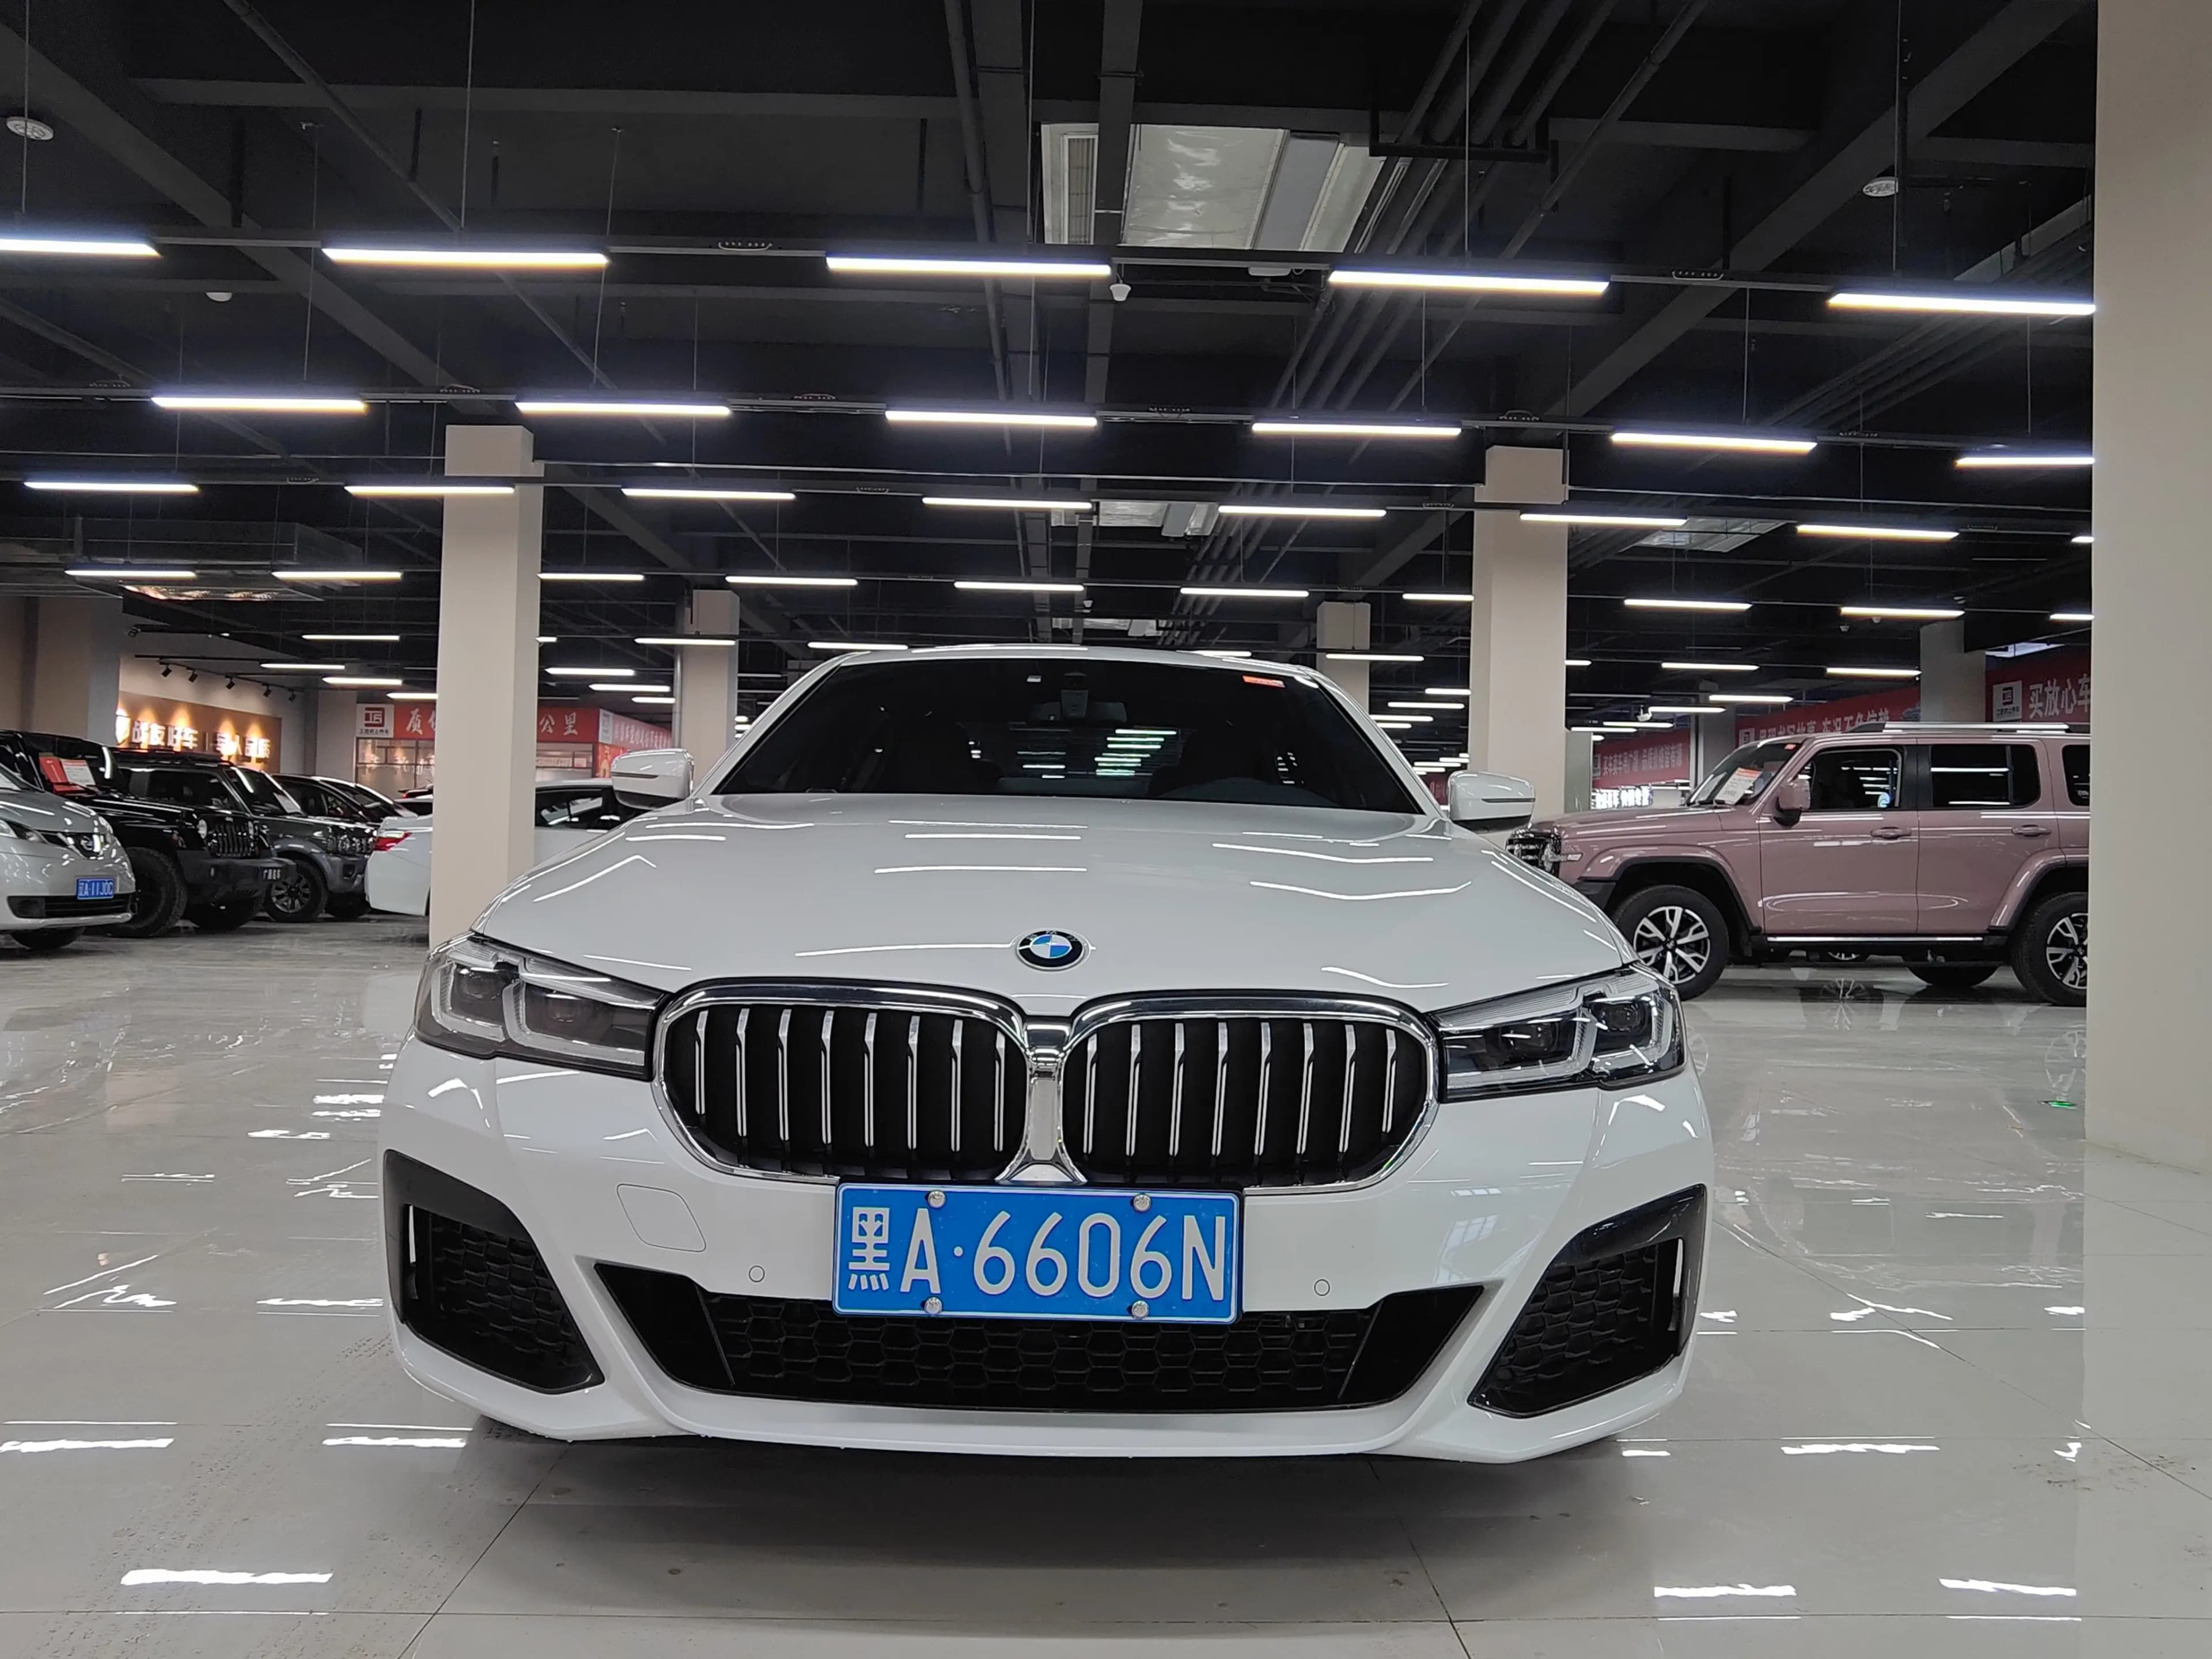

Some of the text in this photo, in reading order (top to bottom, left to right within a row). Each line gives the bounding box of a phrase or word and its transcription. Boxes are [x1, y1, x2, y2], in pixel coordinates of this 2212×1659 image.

[2029, 673, 2090, 719] 买放心车
[539, 712, 578, 735] 公里
[848, 1206, 1225, 1301] 黑A·6606N
